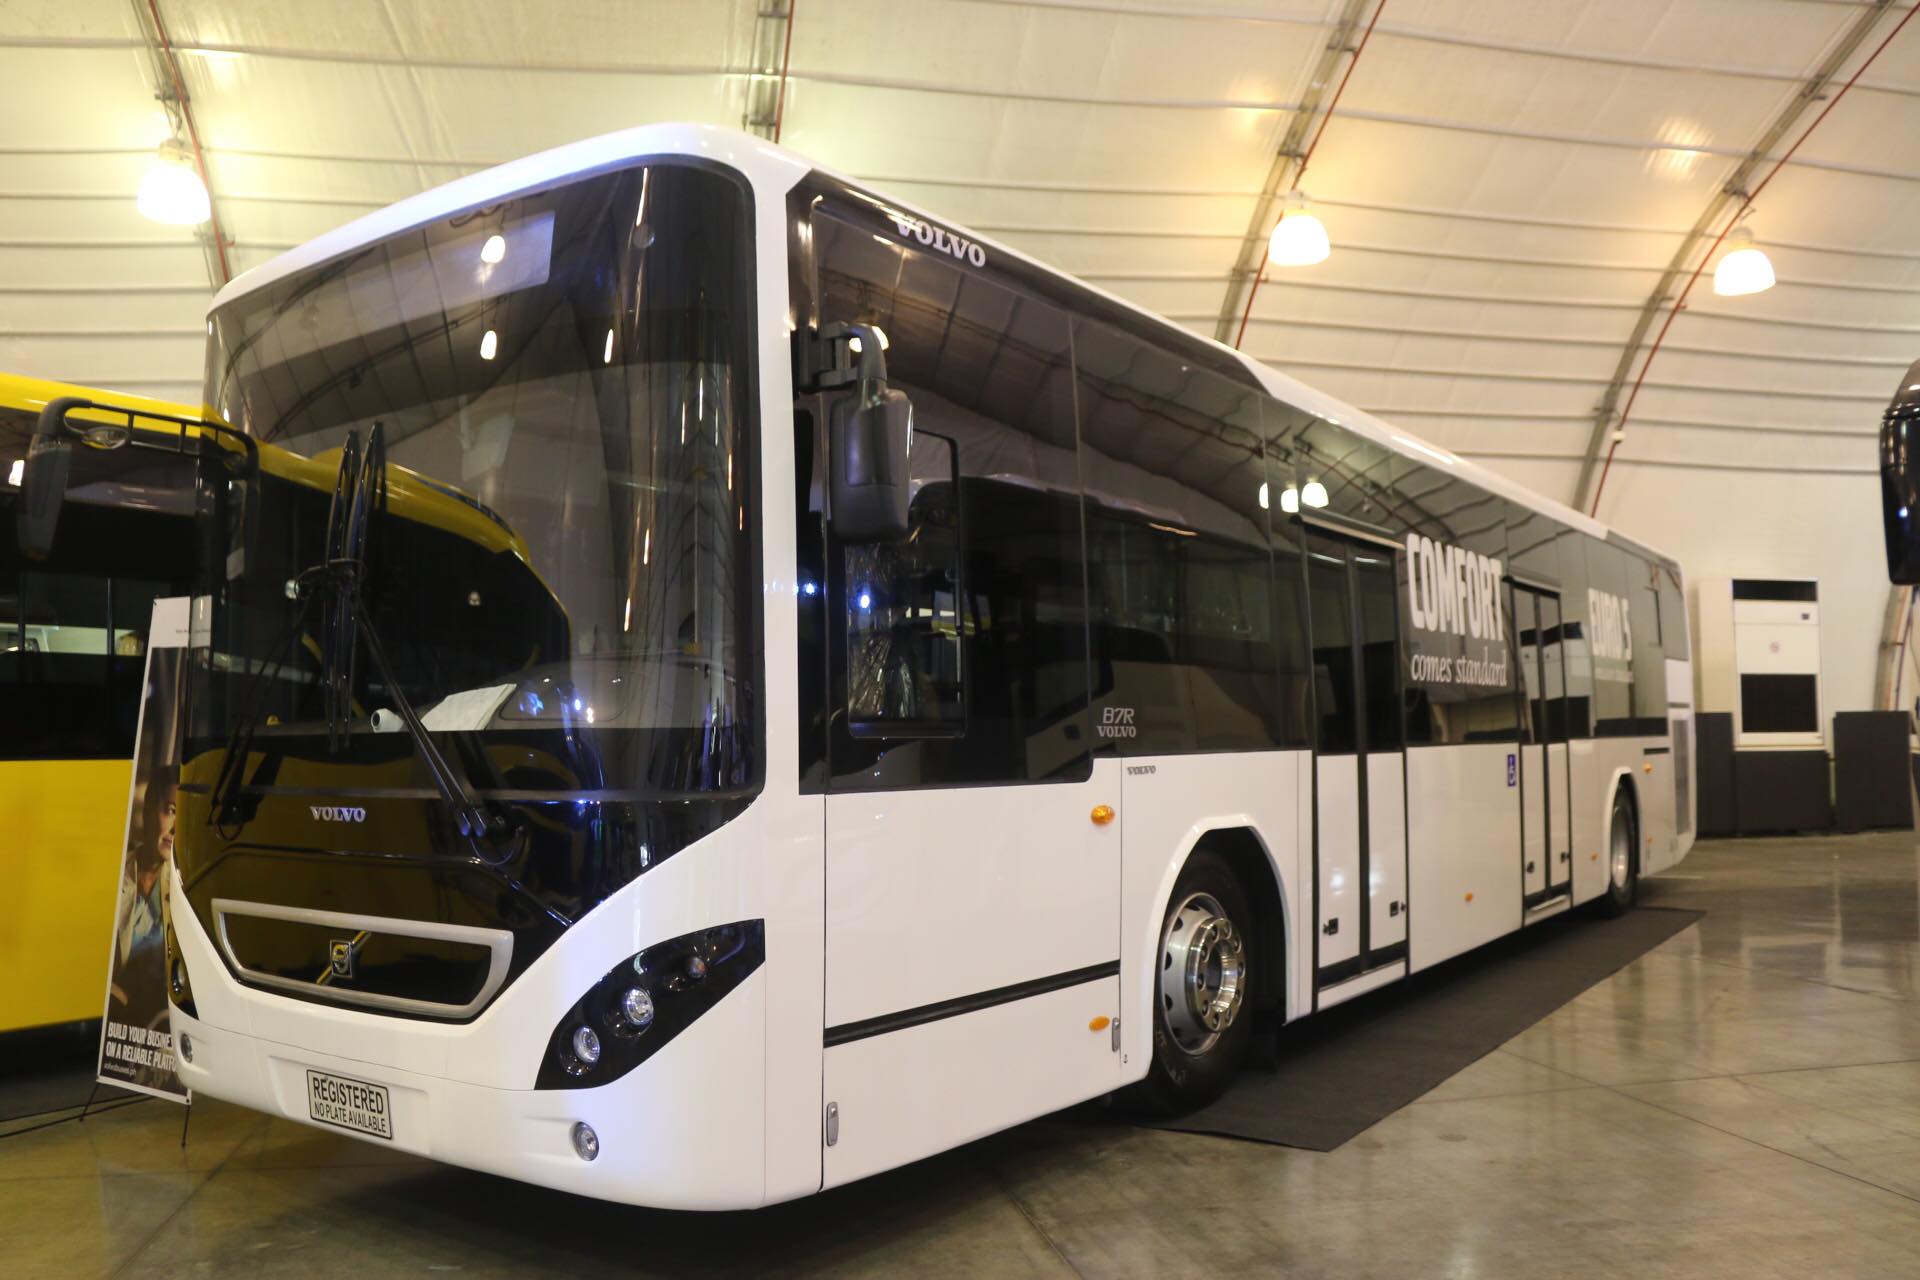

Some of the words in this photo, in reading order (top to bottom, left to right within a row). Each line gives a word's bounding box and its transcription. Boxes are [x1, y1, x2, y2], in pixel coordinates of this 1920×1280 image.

[894, 216, 986, 268] VOLVO
[1407, 533, 1503, 641] COMFORT
[1411, 654, 1452, 682] comes
[1456, 646, 1507, 686] standard
[1103, 707, 1134, 724] B7R
[1096, 725, 1136, 738] VOLVO
[310, 806, 366, 822] VOLVO
[108, 1022, 128, 1040] BUILD
[129, 1025, 147, 1043] YOUR
[147, 1030, 173, 1050] BUSINE
[106, 1041, 116, 1057] ON
[116, 1043, 121, 1059] A
[122, 1045, 152, 1066] RELIABLE
[153, 1052, 177, 1072] PLATFO
[313, 1077, 384, 1115] REGISTERED
[314, 1101, 324, 1117] NO
[325, 1104, 347, 1123] PLATE
[348, 1110, 387, 1133] AVAILABLE
